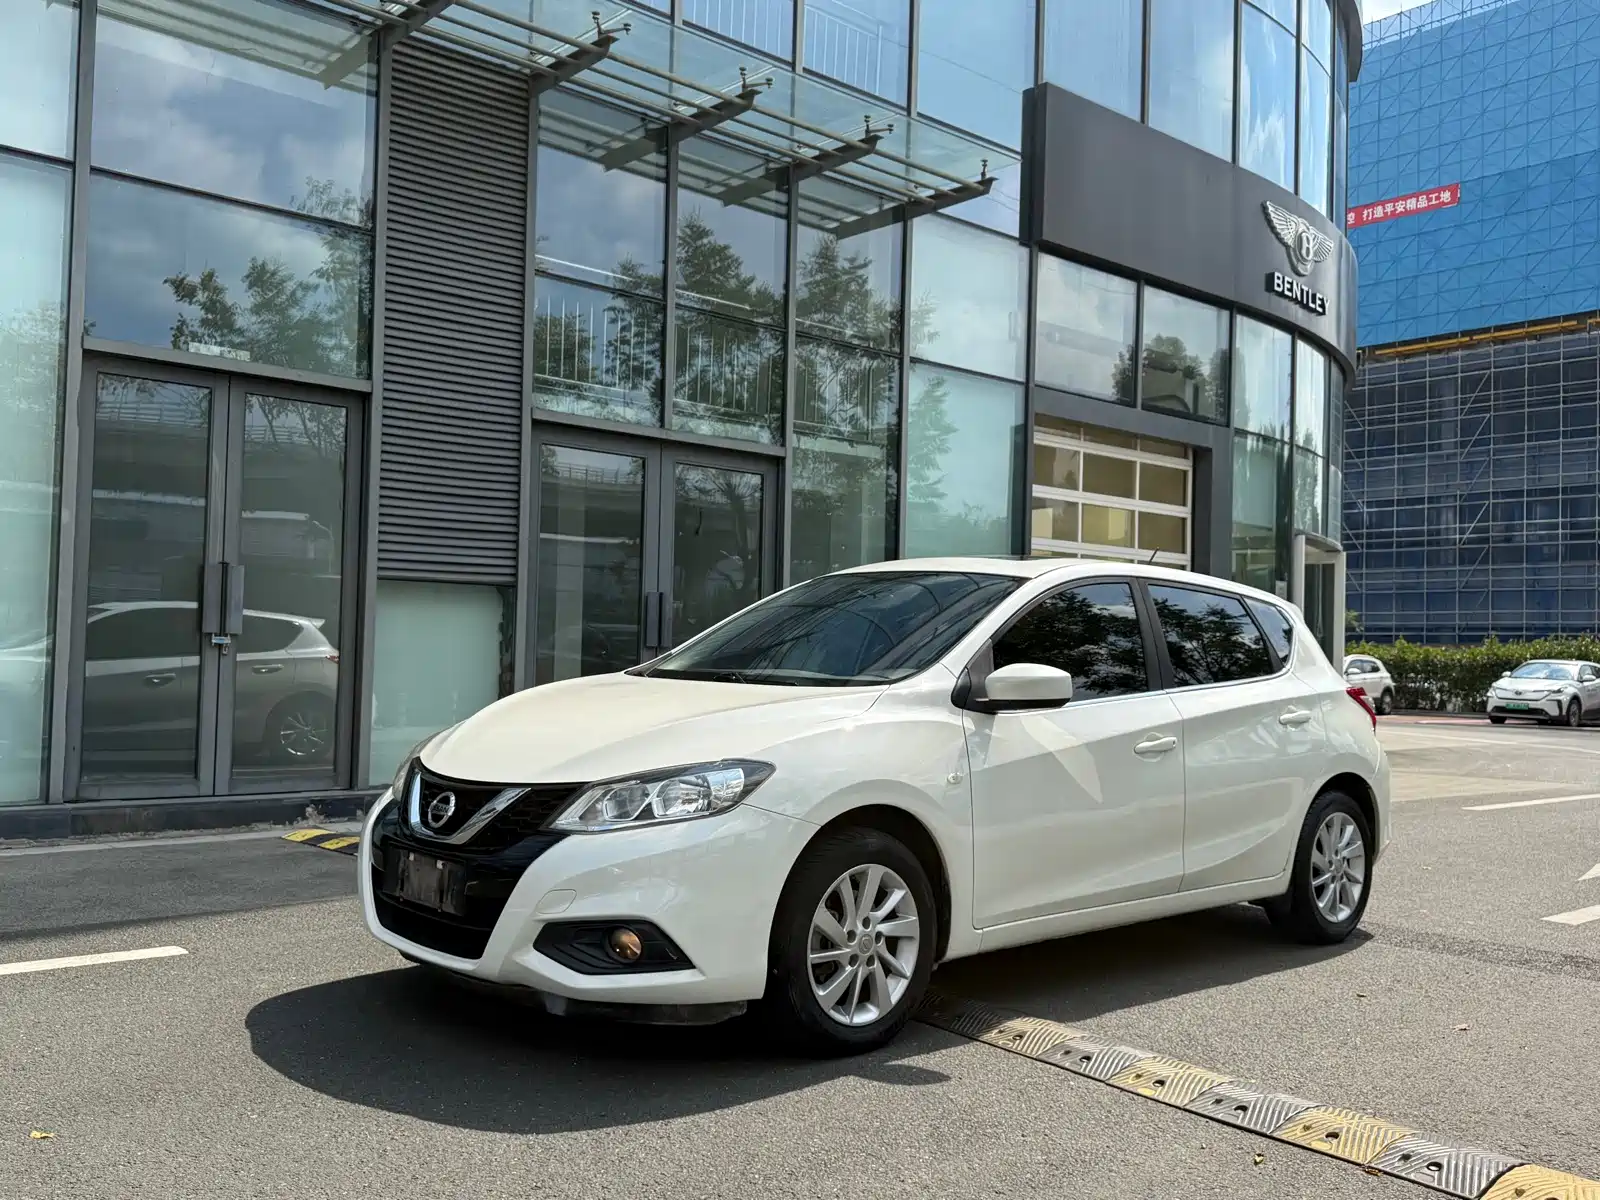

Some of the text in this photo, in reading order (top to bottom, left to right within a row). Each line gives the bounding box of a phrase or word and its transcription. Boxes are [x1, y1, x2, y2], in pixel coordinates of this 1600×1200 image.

[1362, 189, 1451, 221] 打造平安精品工地
[1273, 271, 1331, 316] BENTLEY
